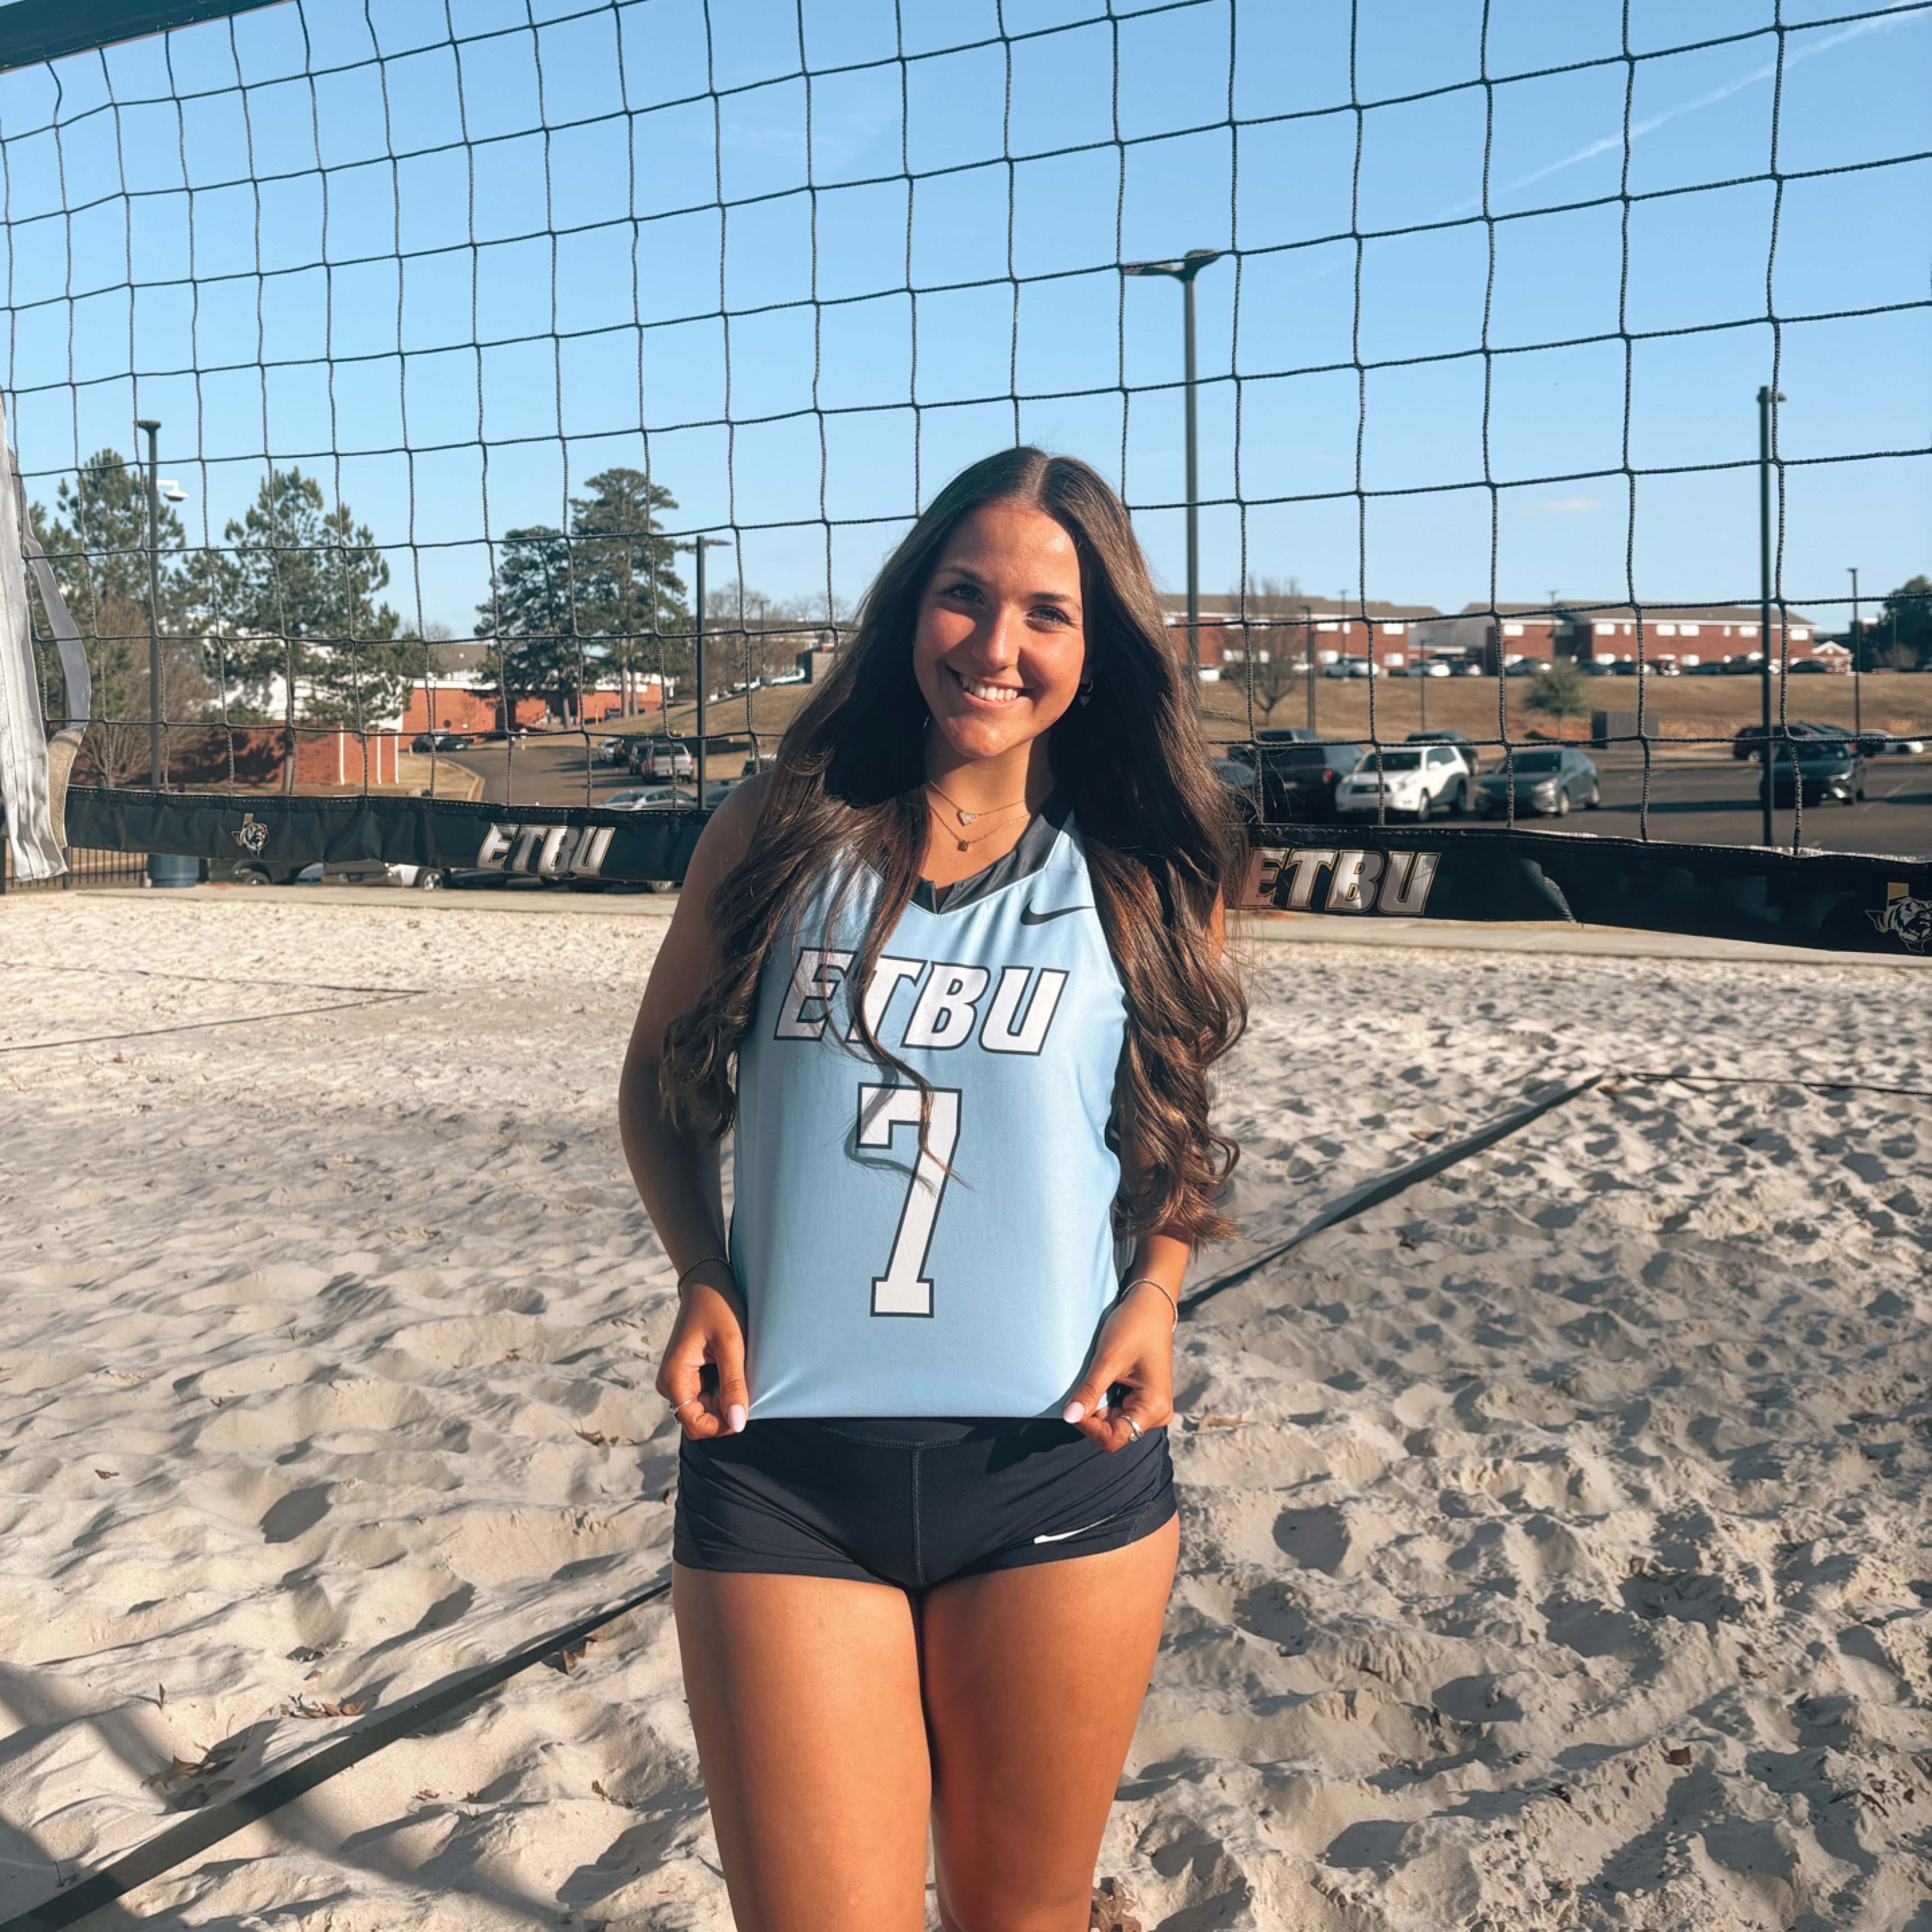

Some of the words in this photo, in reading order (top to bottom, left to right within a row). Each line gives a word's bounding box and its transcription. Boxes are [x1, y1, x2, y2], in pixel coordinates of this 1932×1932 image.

[478, 823, 616, 877] ETBU
[1239, 848, 1441, 915] ETBU
[774, 948, 1070, 1055] ETBU
[857, 1082, 962, 1318] 7
